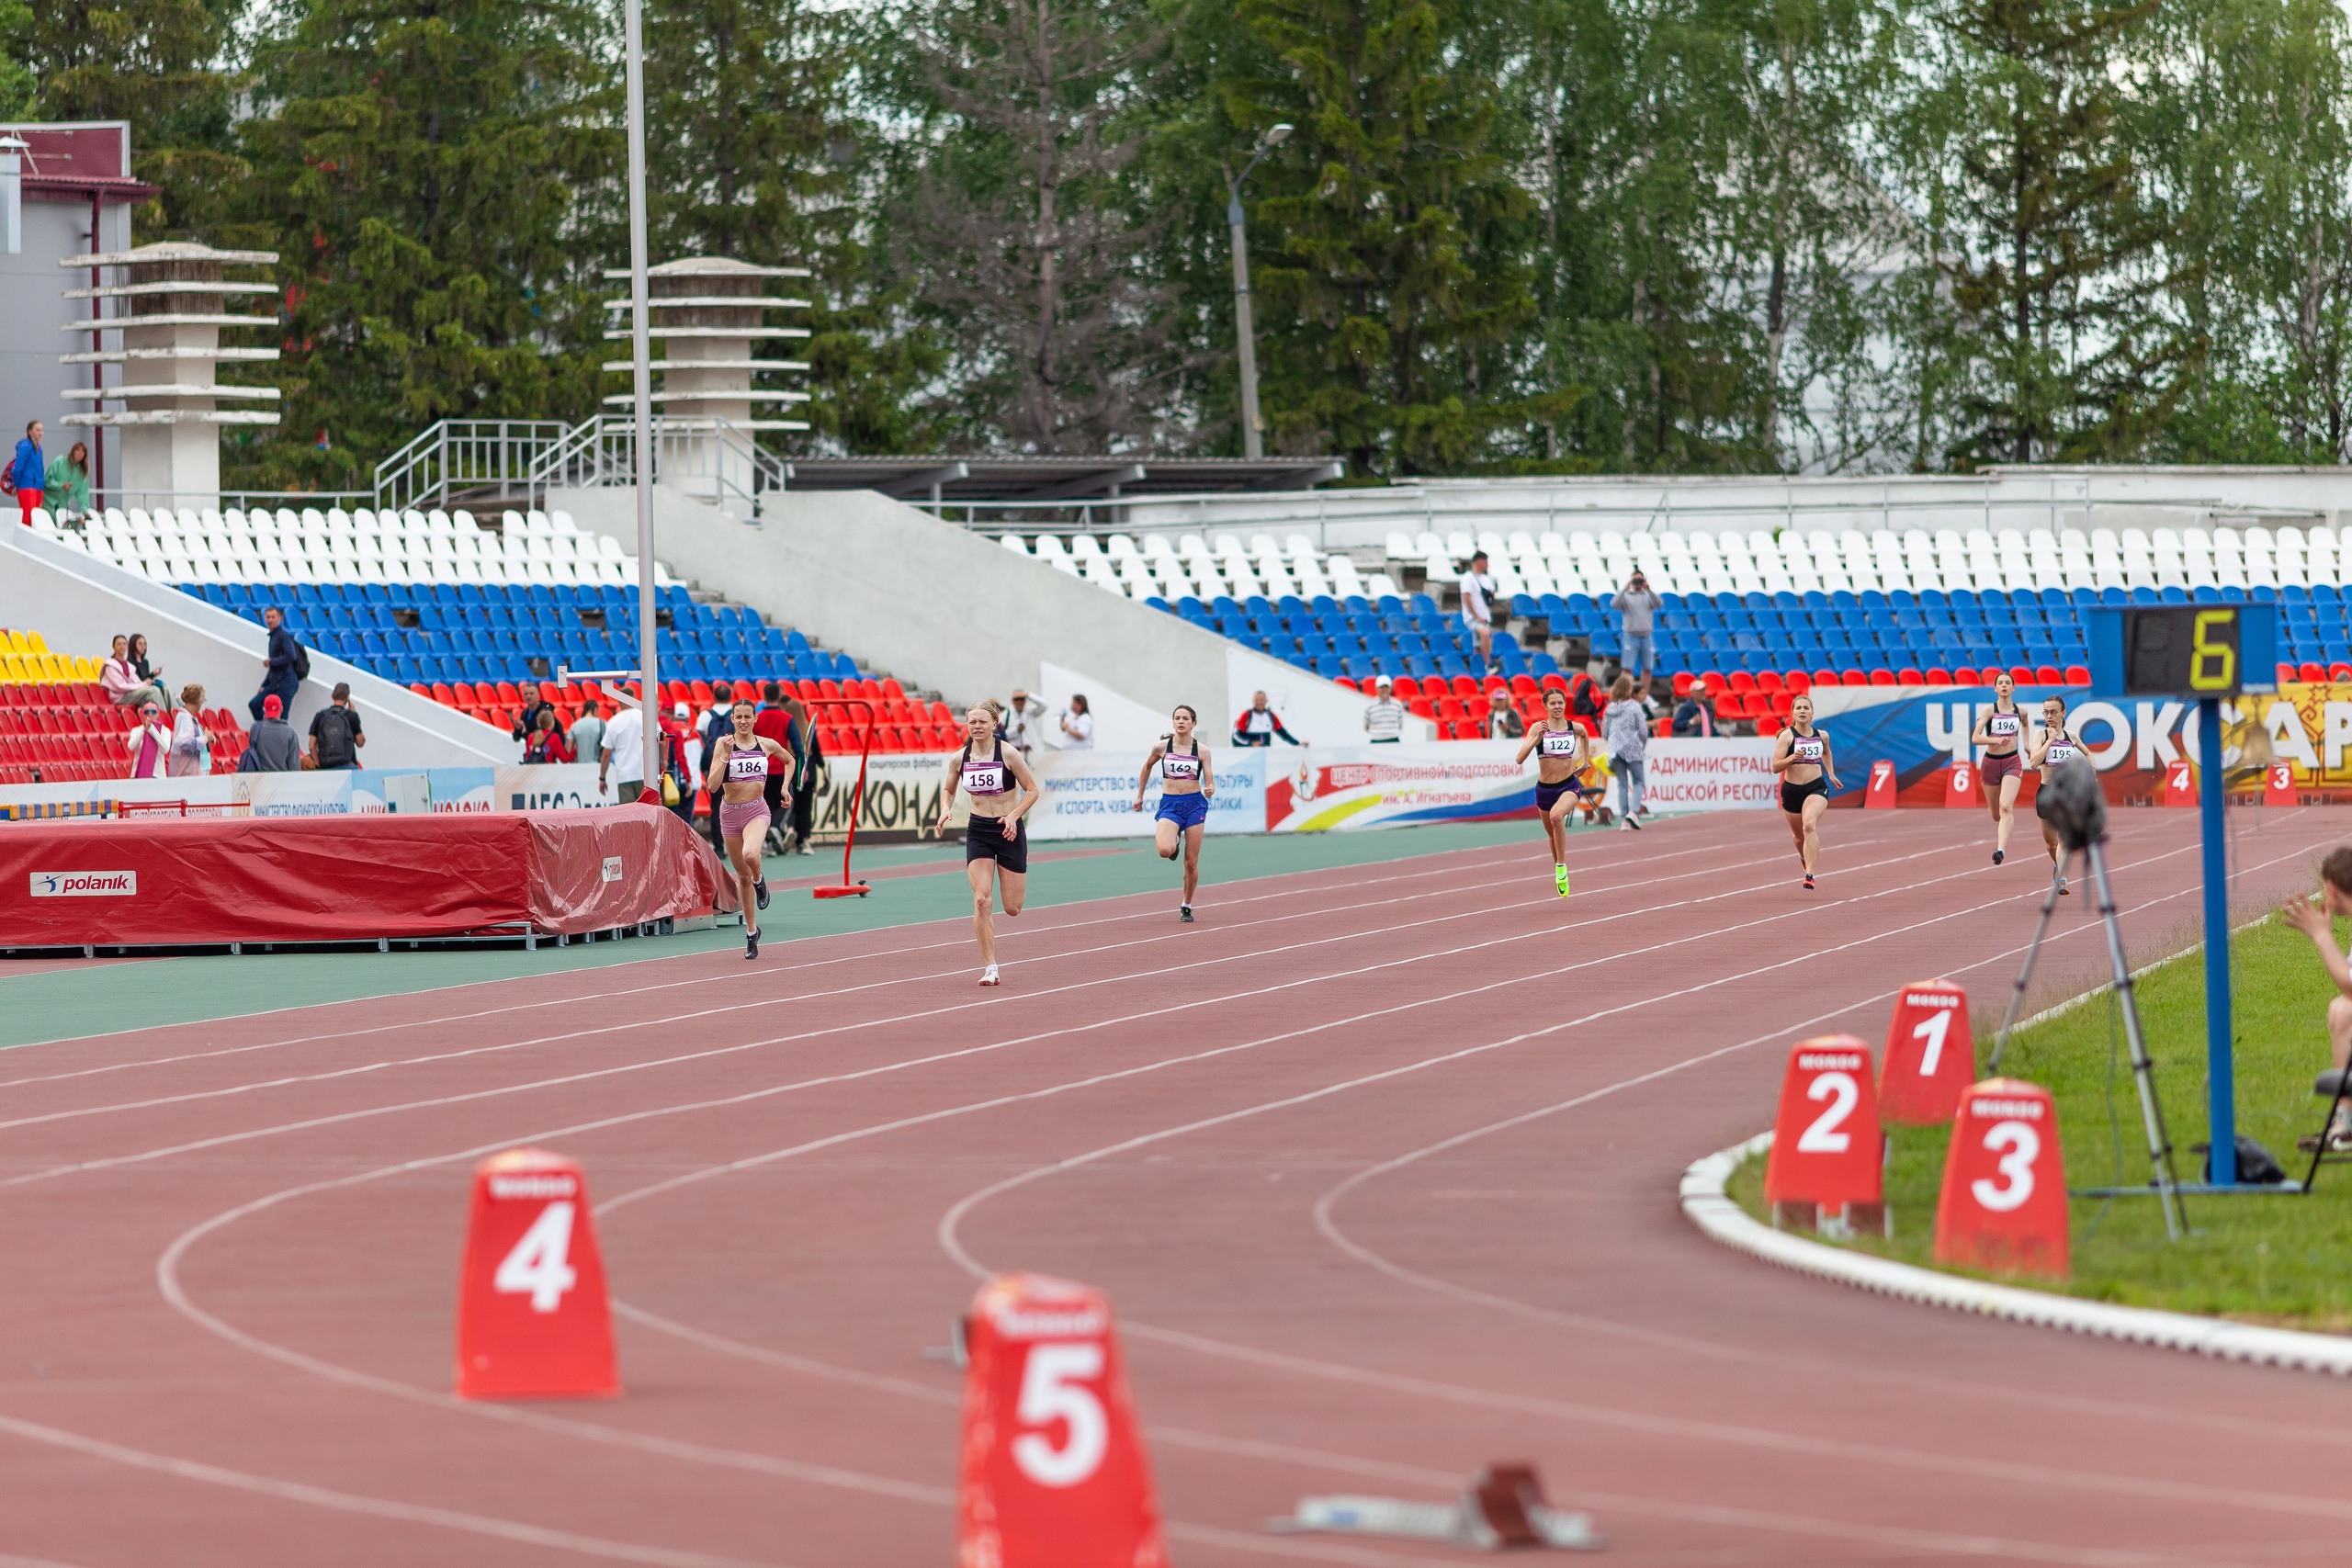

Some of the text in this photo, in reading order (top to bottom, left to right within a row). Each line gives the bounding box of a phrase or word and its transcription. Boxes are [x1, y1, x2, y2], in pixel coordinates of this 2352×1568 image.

[2189, 608, 2235, 691] 6
[1997, 721, 2015, 730] 196
[1550, 739, 1570, 750] 122
[1926, 701, 2352, 772] ЧБОКСАР
[1801, 746, 1819, 756] 353
[2052, 749, 2071, 760] 195
[737, 761, 762, 773] 186
[1170, 762, 1192, 773] 162
[1650, 756, 1773, 776] АДМИНИСТРАЦ
[969, 773, 995, 787] 158
[1045, 777, 1125, 792] МИНИСТЕРСТВО
[1201, 774, 1253, 788] ЛЬТУРЫ
[1873, 769, 1890, 792] 7
[1953, 769, 1970, 793] 6
[2171, 766, 2189, 792] 4
[2273, 767, 2290, 790] 3
[1641, 780, 1780, 801] ВАШСКОЙ РЕСПУБ
[741, 799, 759, 808] PRO
[1056, 801, 1063, 815] И
[1065, 800, 1105, 815] СПОРТА
[1107, 795, 1159, 814] ЧУВАСКО
[62, 874, 130, 894] polanik
[1906, 994, 1960, 1008] MONDO
[1912, 1009, 1952, 1077] 1
[1798, 1053, 1862, 1071] MONDO
[1796, 1070, 1859, 1154] 2
[1970, 1120, 2041, 1213] 3
[492, 1199, 578, 1314] 4
[1010, 1341, 1110, 1489] 5
